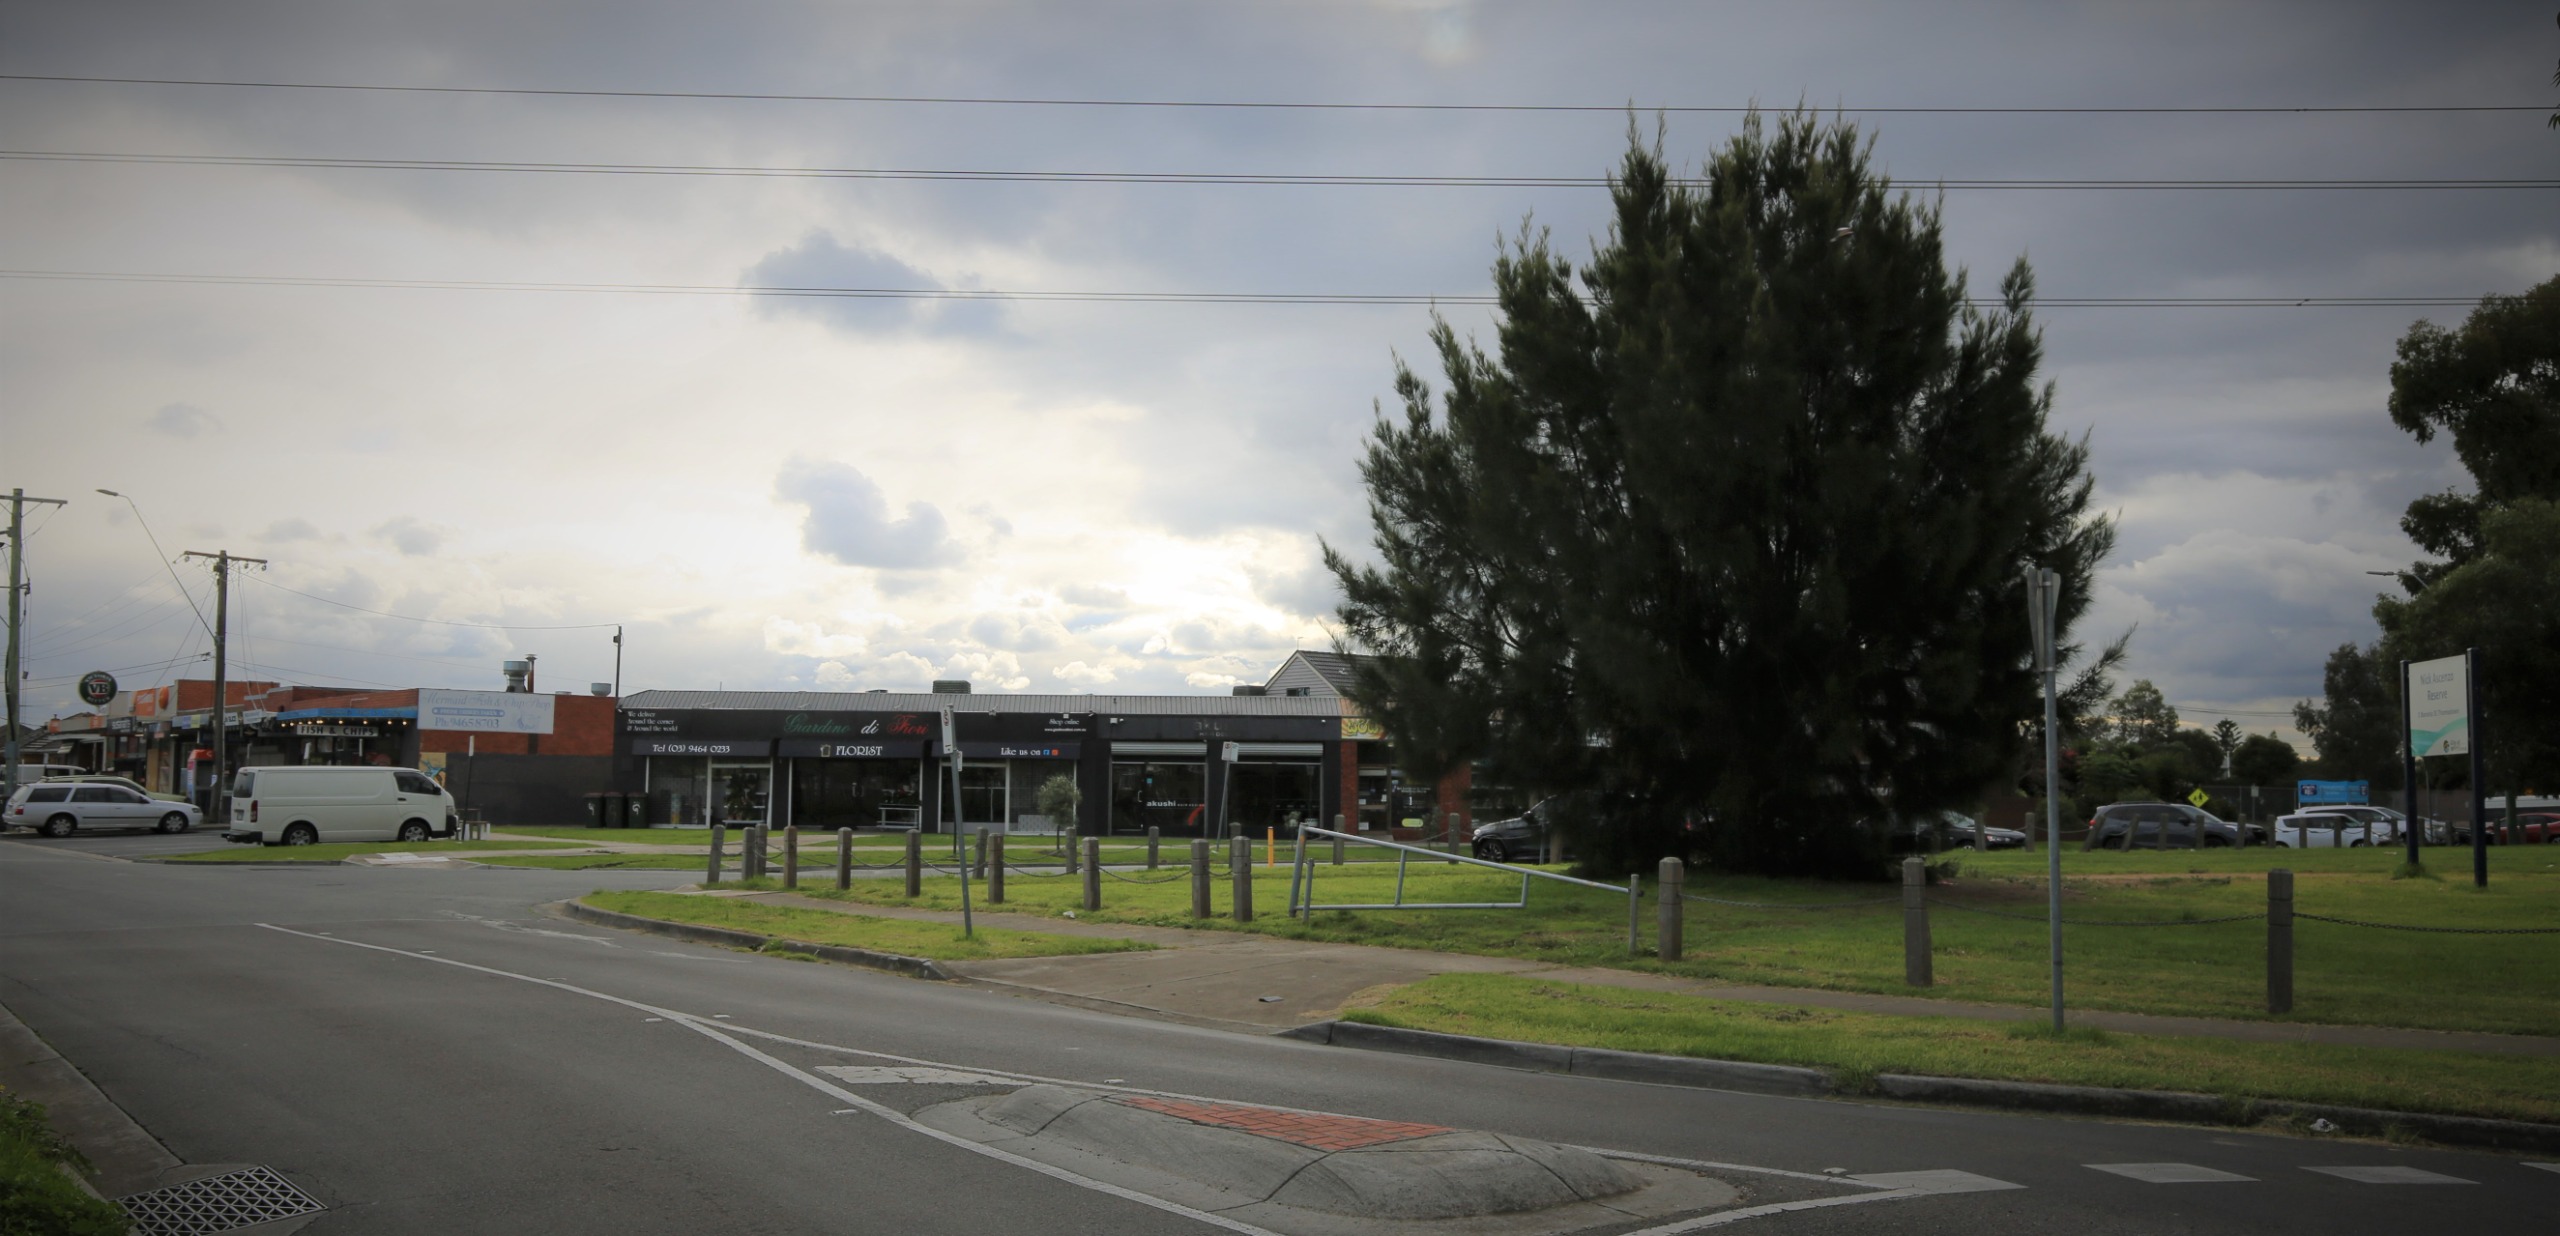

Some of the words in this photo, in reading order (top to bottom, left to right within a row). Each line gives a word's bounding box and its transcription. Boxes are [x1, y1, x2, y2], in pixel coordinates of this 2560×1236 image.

[89, 683, 109, 694] VB
[427, 692, 467, 706] Mermaid
[783, 713, 851, 734] Giardino
[860, 719, 880, 734] di
[887, 714, 929, 735] Fiori
[301, 726, 323, 734] FISH
[343, 727, 374, 736] CHIPS
[653, 744, 666, 752] Tel
[668, 744, 686, 752] (03)
[688, 744, 707, 753] 9464
[709, 745, 730, 753] 0233
[835, 745, 883, 756] FLORIST
[1000, 747, 1017, 756] Like
